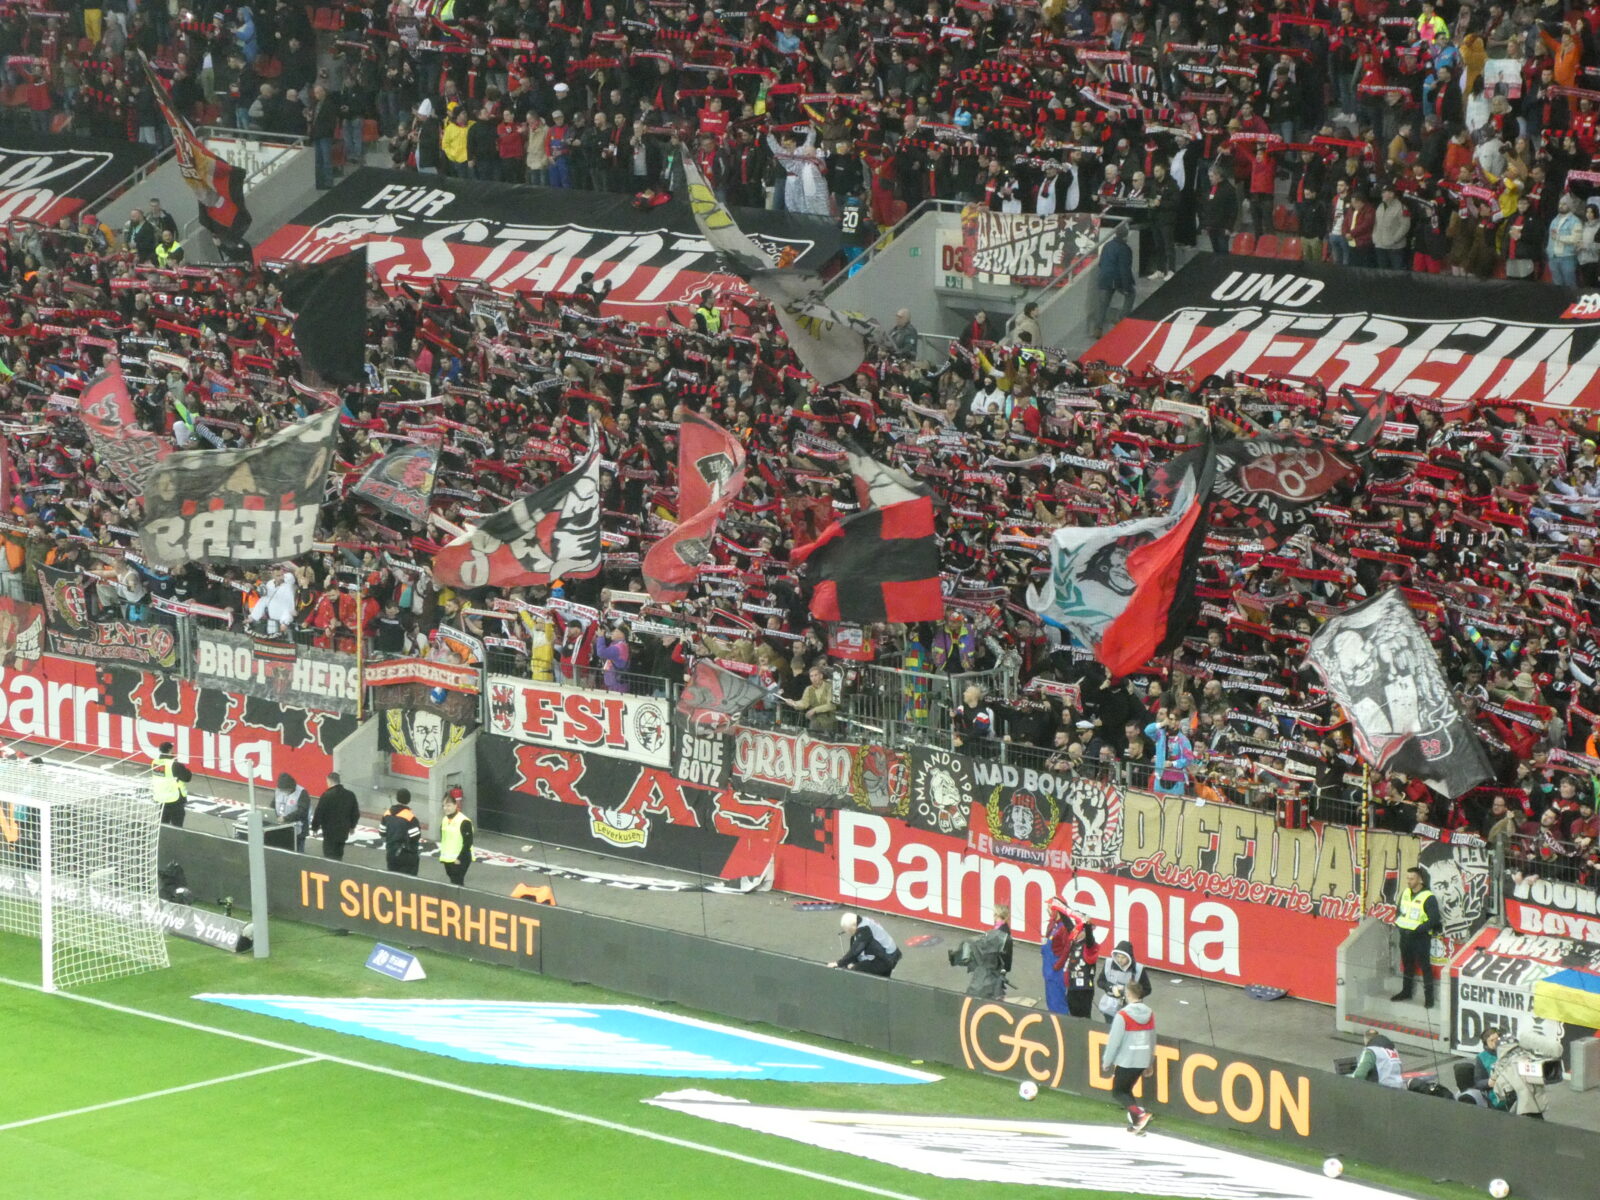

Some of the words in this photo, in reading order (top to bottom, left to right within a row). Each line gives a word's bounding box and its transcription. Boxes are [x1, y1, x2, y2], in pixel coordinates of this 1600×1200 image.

[361, 184, 457, 217] FÜR
[385, 222, 718, 303] STADT
[1211, 271, 1326, 308] UND
[1155, 308, 1600, 405] VEREIN
[0, 671, 273, 782] armenia
[521, 688, 626, 747] FSI
[679, 757, 722, 788] BOYZ
[682, 733, 724, 766] SIDE
[973, 762, 1019, 788] MAD
[1120, 790, 1421, 905] DIFFIDATI
[838, 810, 1241, 977] Barmenia
[1131, 850, 1313, 914] Ausgesperrte
[204, 921, 239, 945] trive
[300, 870, 330, 910] IT
[339, 878, 541, 957] SICHERHEIT
[1461, 955, 1531, 986] DER
[1460, 983, 1496, 1008] GEHT
[1498, 989, 1525, 1011] MIR
